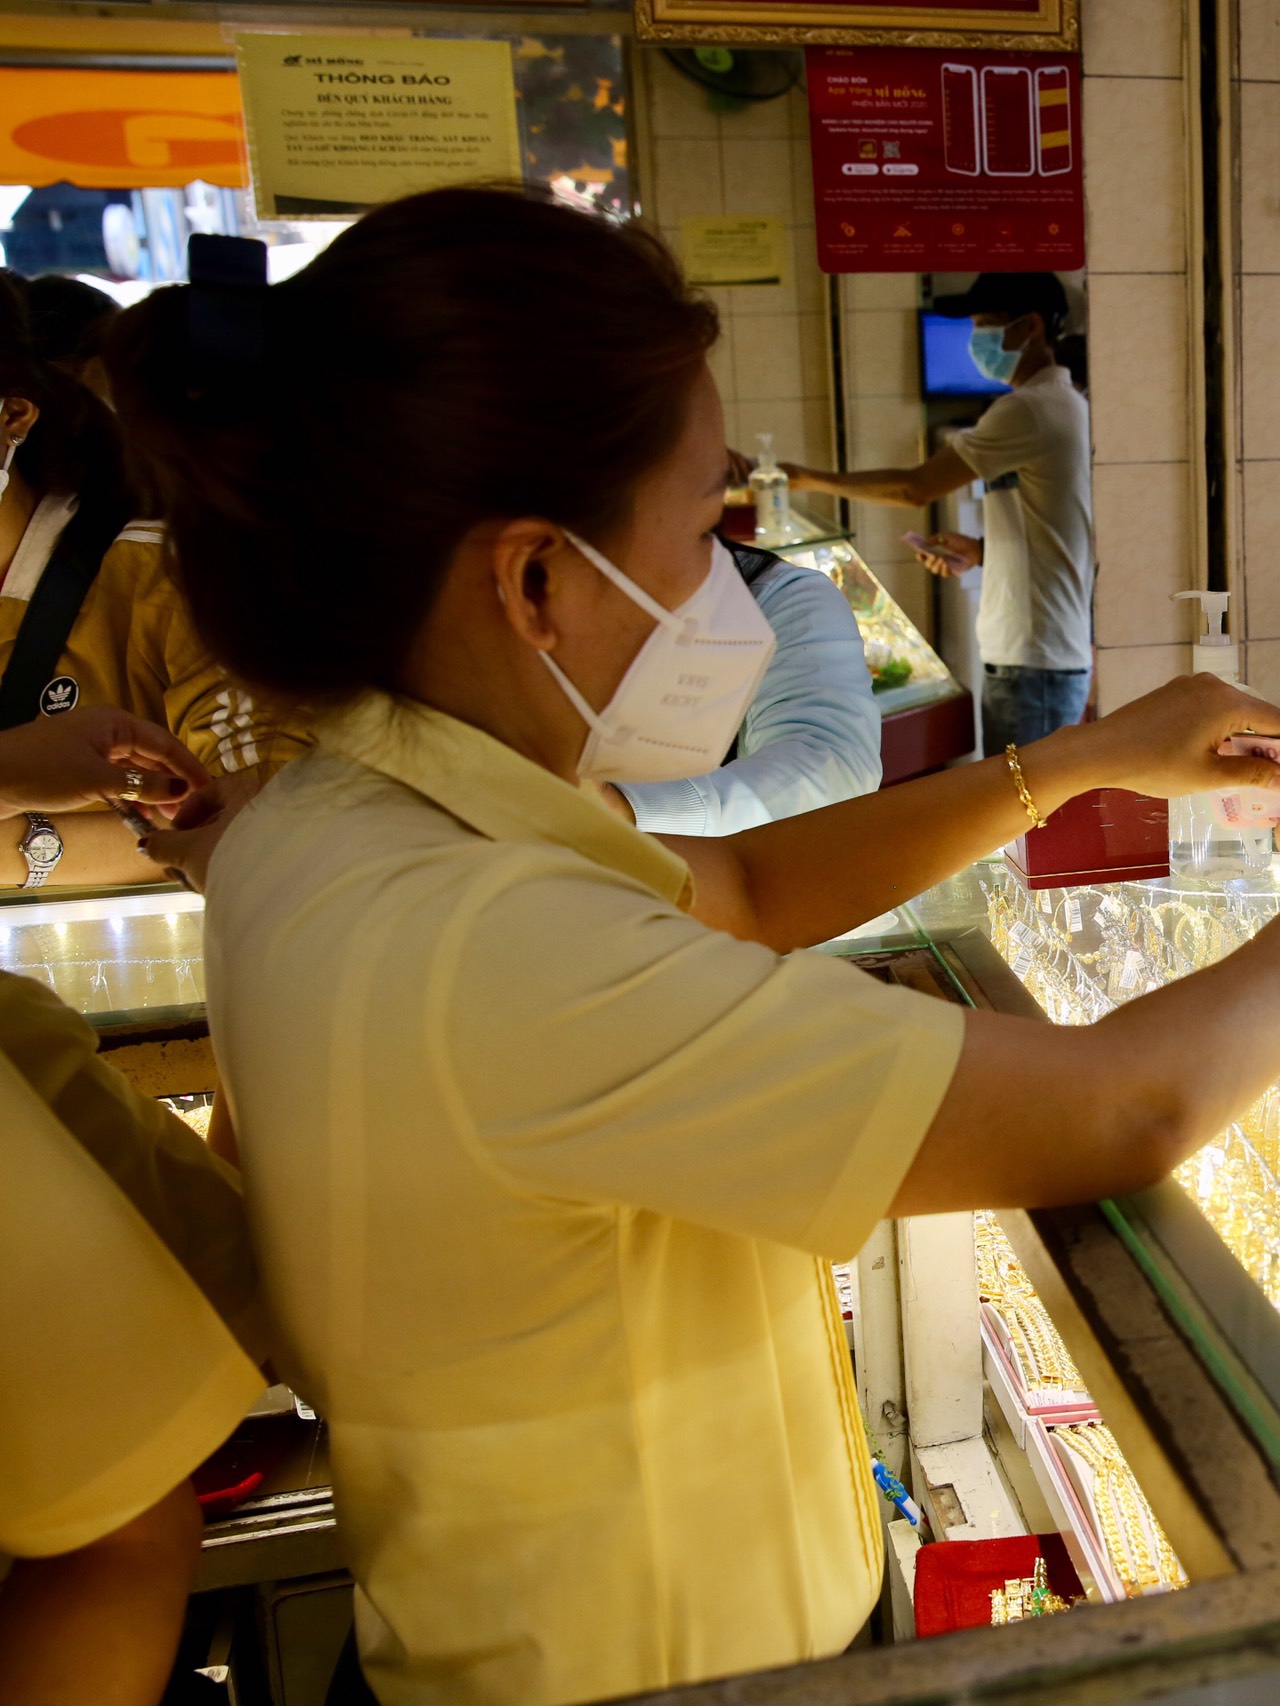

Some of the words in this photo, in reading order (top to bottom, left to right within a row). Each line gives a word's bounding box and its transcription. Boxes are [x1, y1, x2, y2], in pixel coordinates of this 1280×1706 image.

[314, 71, 395, 85] THÔNG
[401, 73, 451, 86] BÁO
[344, 93, 368, 105] QUÝ
[373, 93, 416, 105] KHÁCH
[418, 93, 452, 105] HÀNG
[46, 701, 71, 711] adidas
